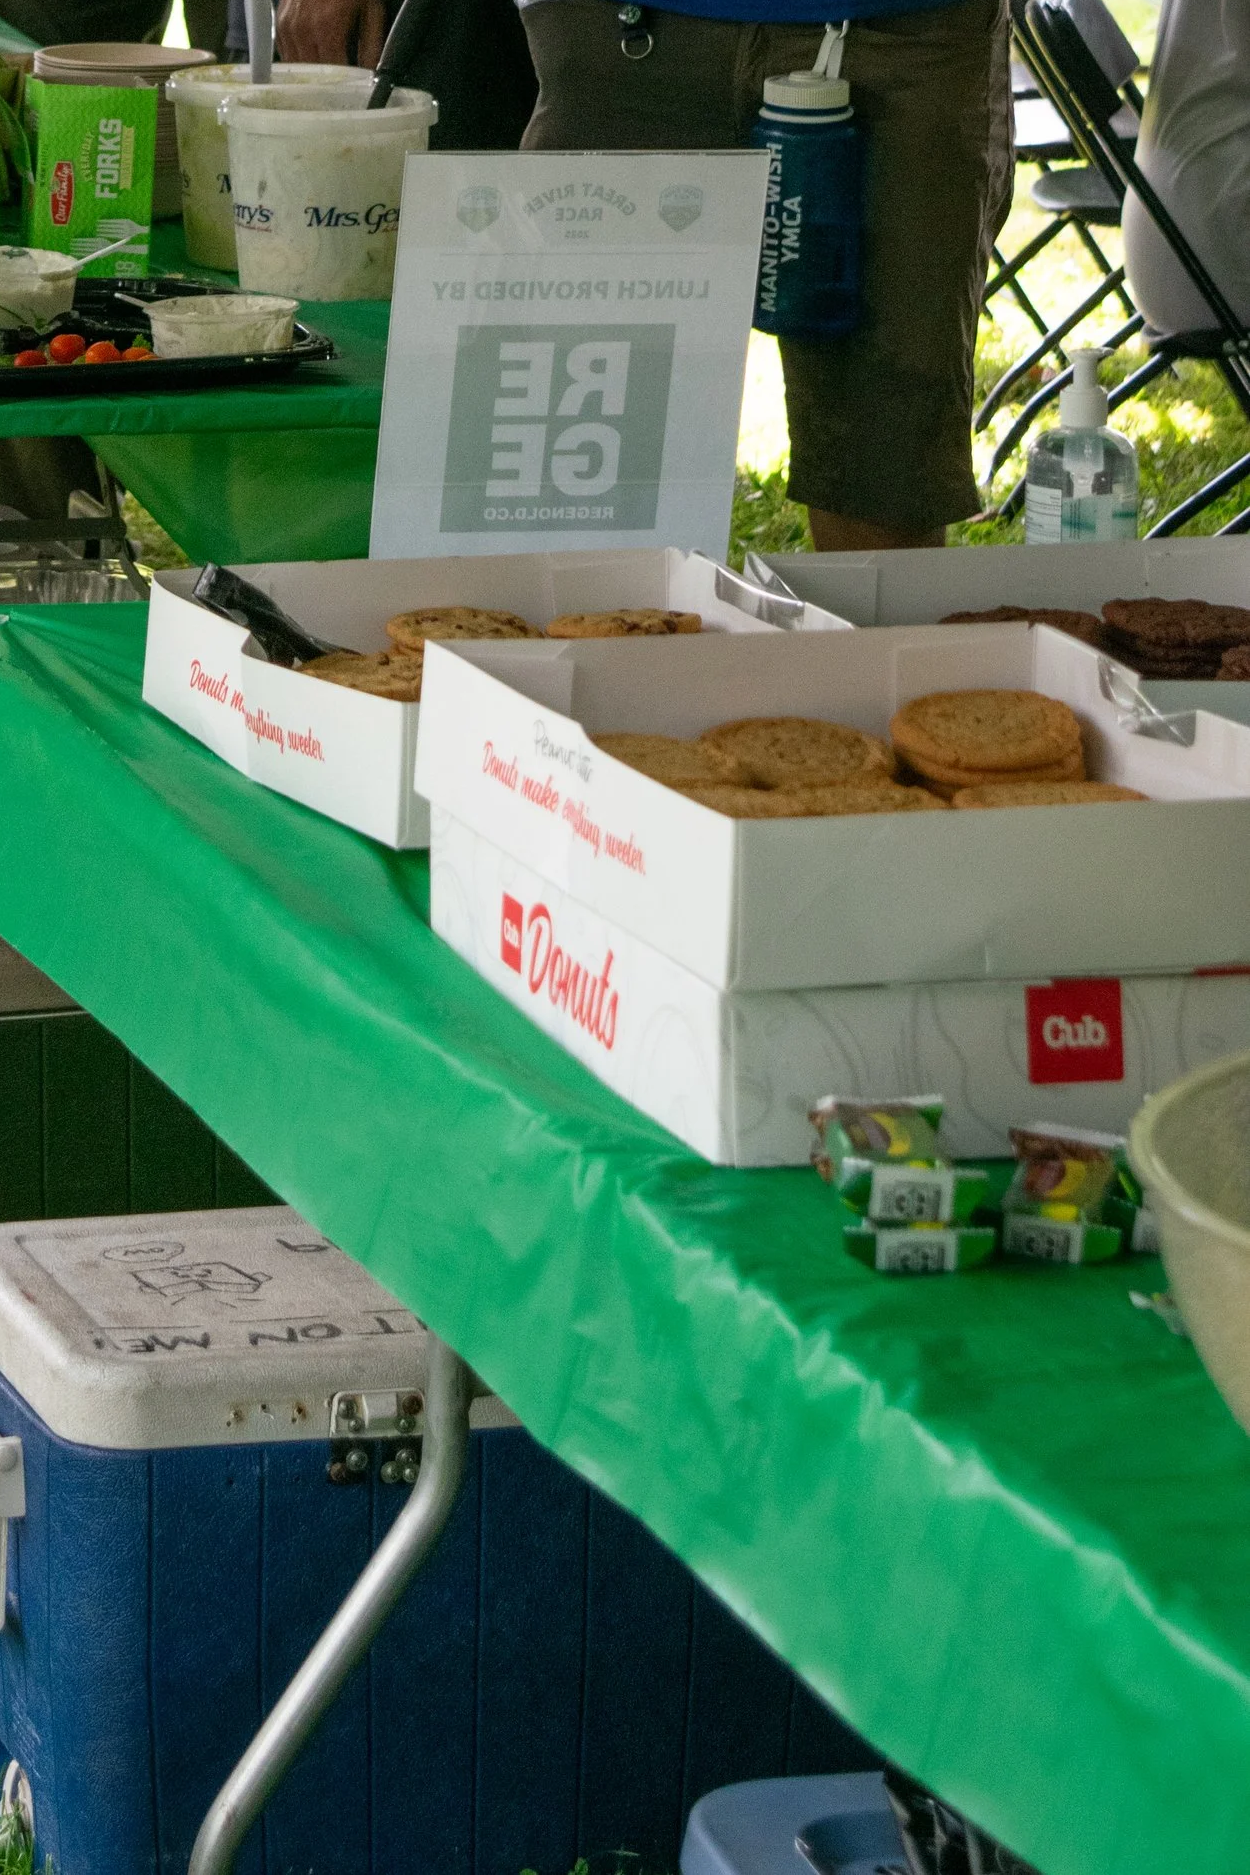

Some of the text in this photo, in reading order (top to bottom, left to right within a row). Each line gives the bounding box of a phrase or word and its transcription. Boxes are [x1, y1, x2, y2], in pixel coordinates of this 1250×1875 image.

[95, 118, 123, 200] FORKS
[304, 205, 361, 228] Mrs.
[760, 141, 783, 313] MANITO-WISH
[781, 195, 802, 264] YMCA
[190, 659, 229, 704] Donuts
[482, 739, 519, 792] Donuts
[521, 774, 560, 813] make
[527, 902, 619, 1051] Donuts
[1042, 1014, 1107, 1051] Cub
[249, 1322, 343, 1347] ON
